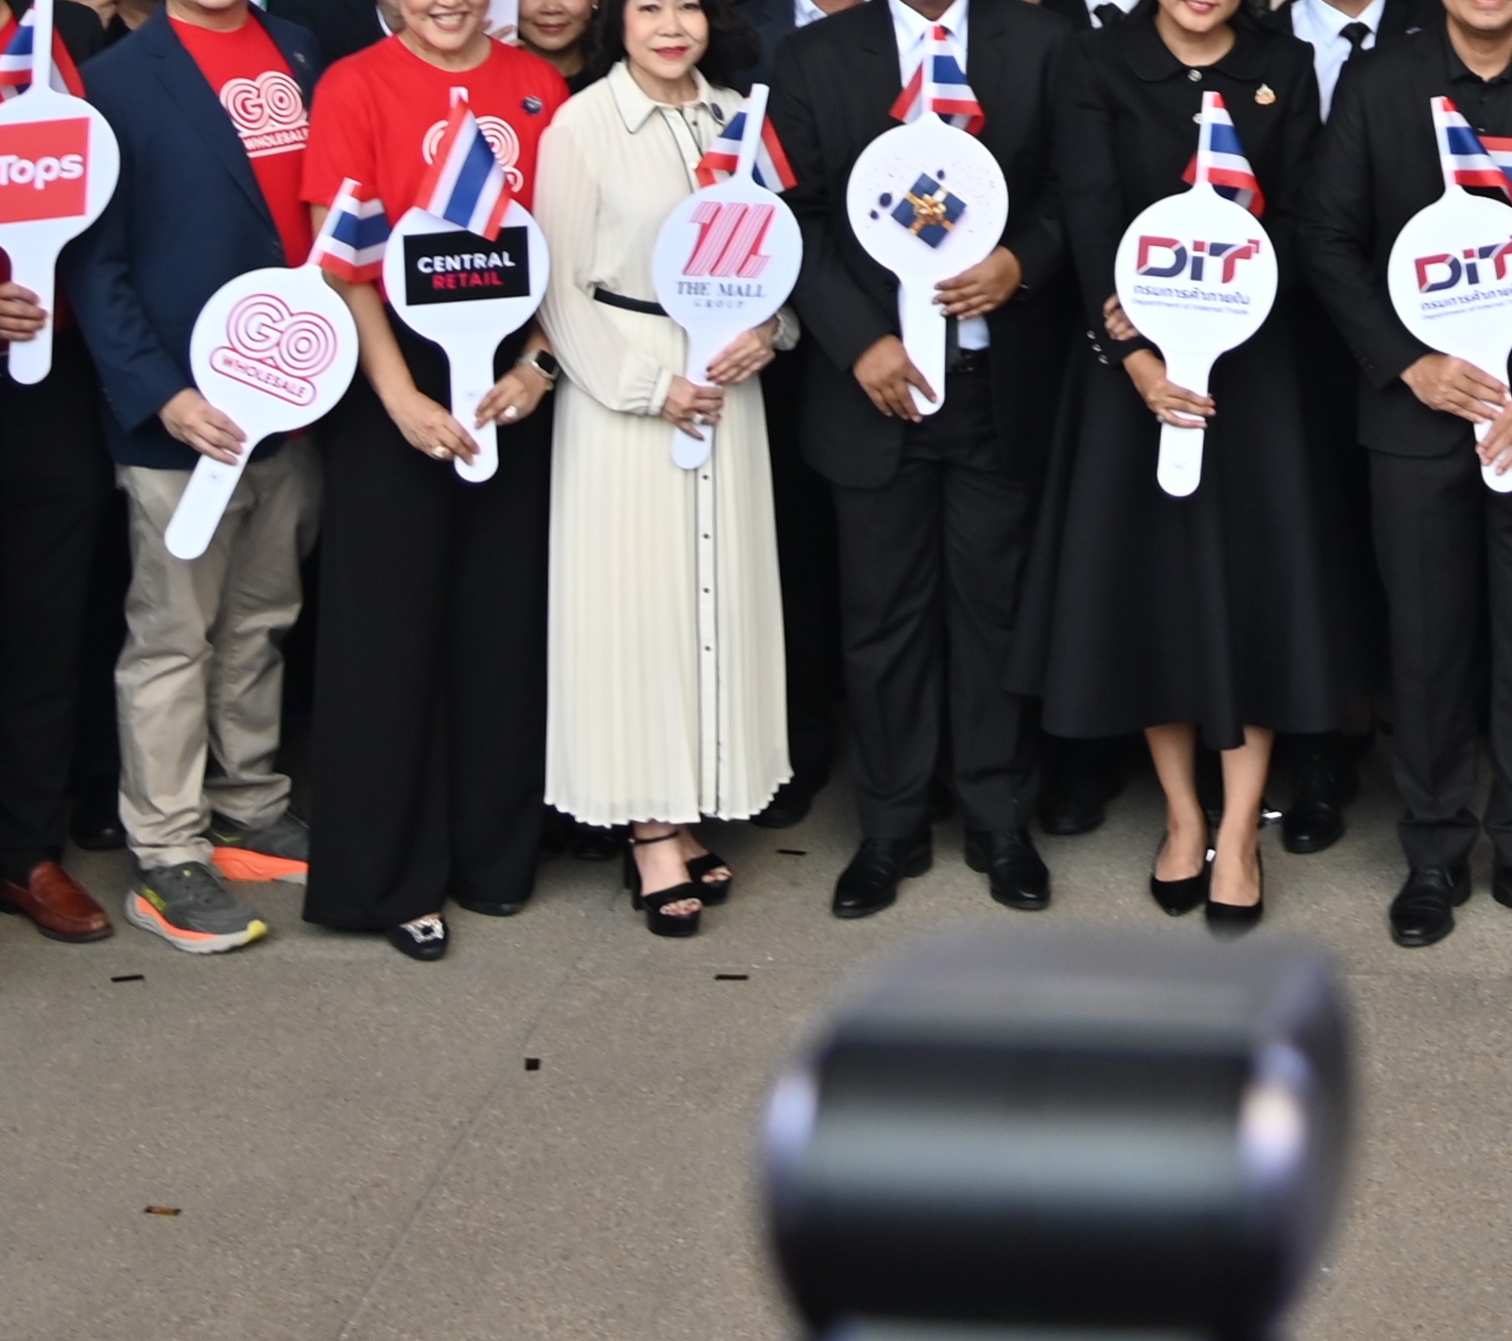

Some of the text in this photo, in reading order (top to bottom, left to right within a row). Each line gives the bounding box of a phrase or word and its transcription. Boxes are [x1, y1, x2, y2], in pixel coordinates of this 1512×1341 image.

[416, 251, 517, 275] CENTRAL
[432, 269, 505, 291] RETAIL
[676, 280, 767, 300] THE MALL
[693, 297, 746, 310] GROUP
[219, 353, 309, 400] WHOLESALE
